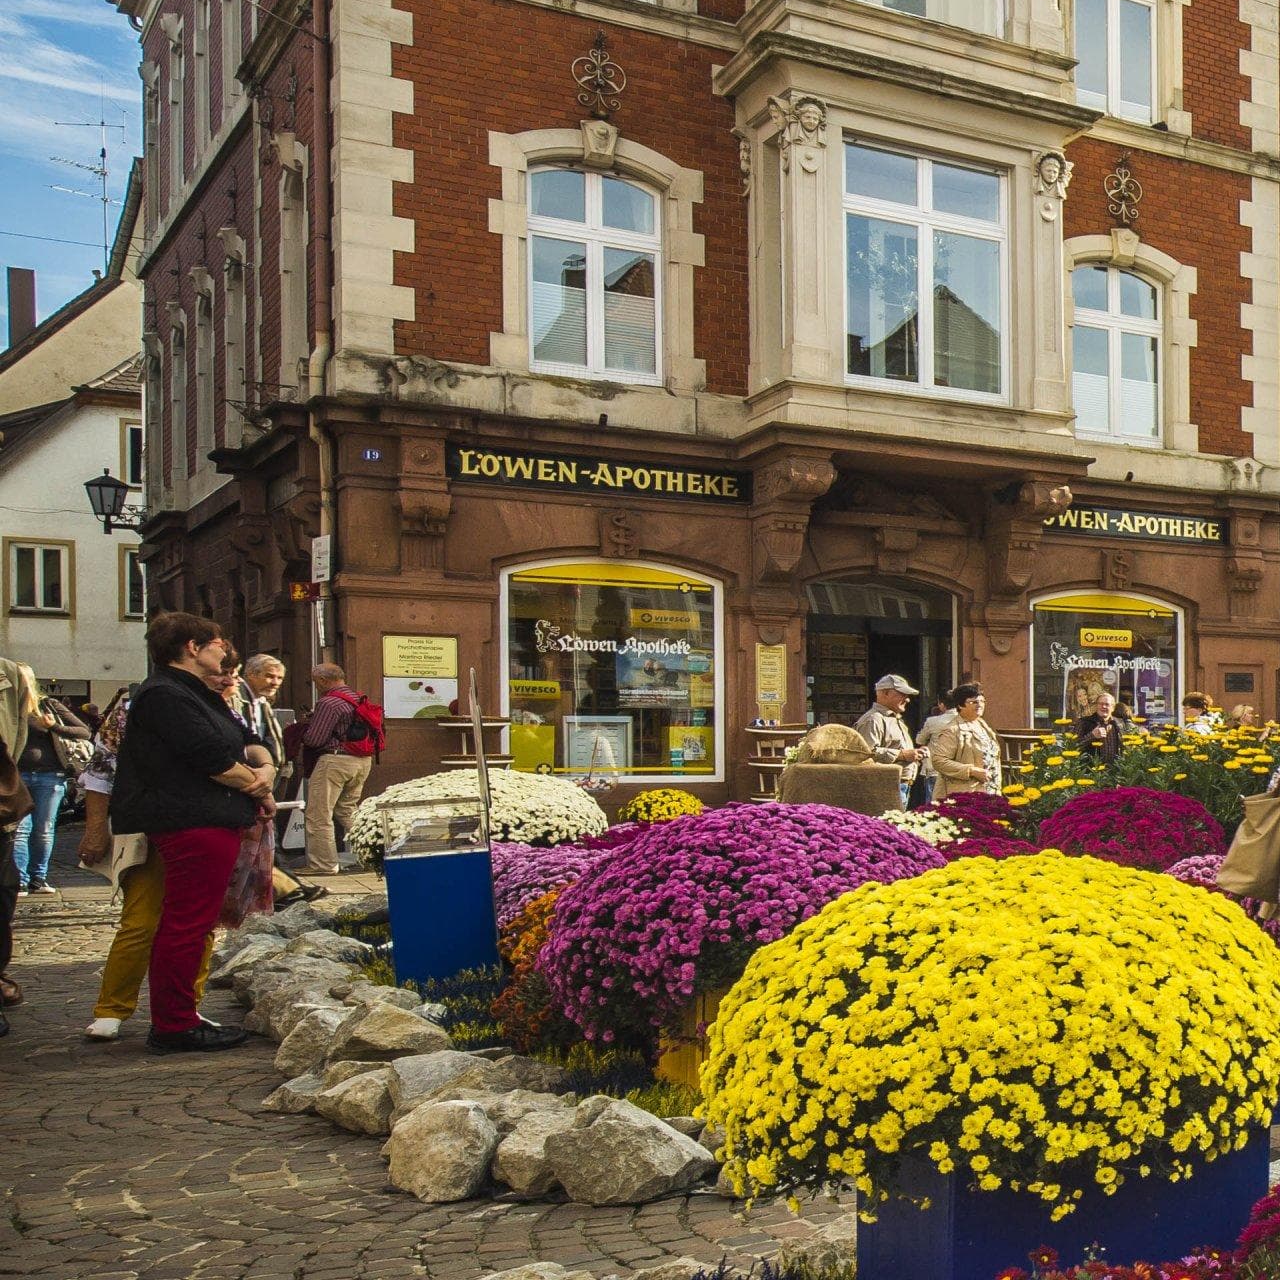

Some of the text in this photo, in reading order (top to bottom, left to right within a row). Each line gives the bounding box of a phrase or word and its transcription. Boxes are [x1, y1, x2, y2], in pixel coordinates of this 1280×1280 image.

[365, 450, 379, 459] 19
[459, 449, 739, 497] LÖWEN-APOTHEKE
[558, 634, 691, 657] Löwen Apotheke
[1095, 634, 1129, 642] vivesco
